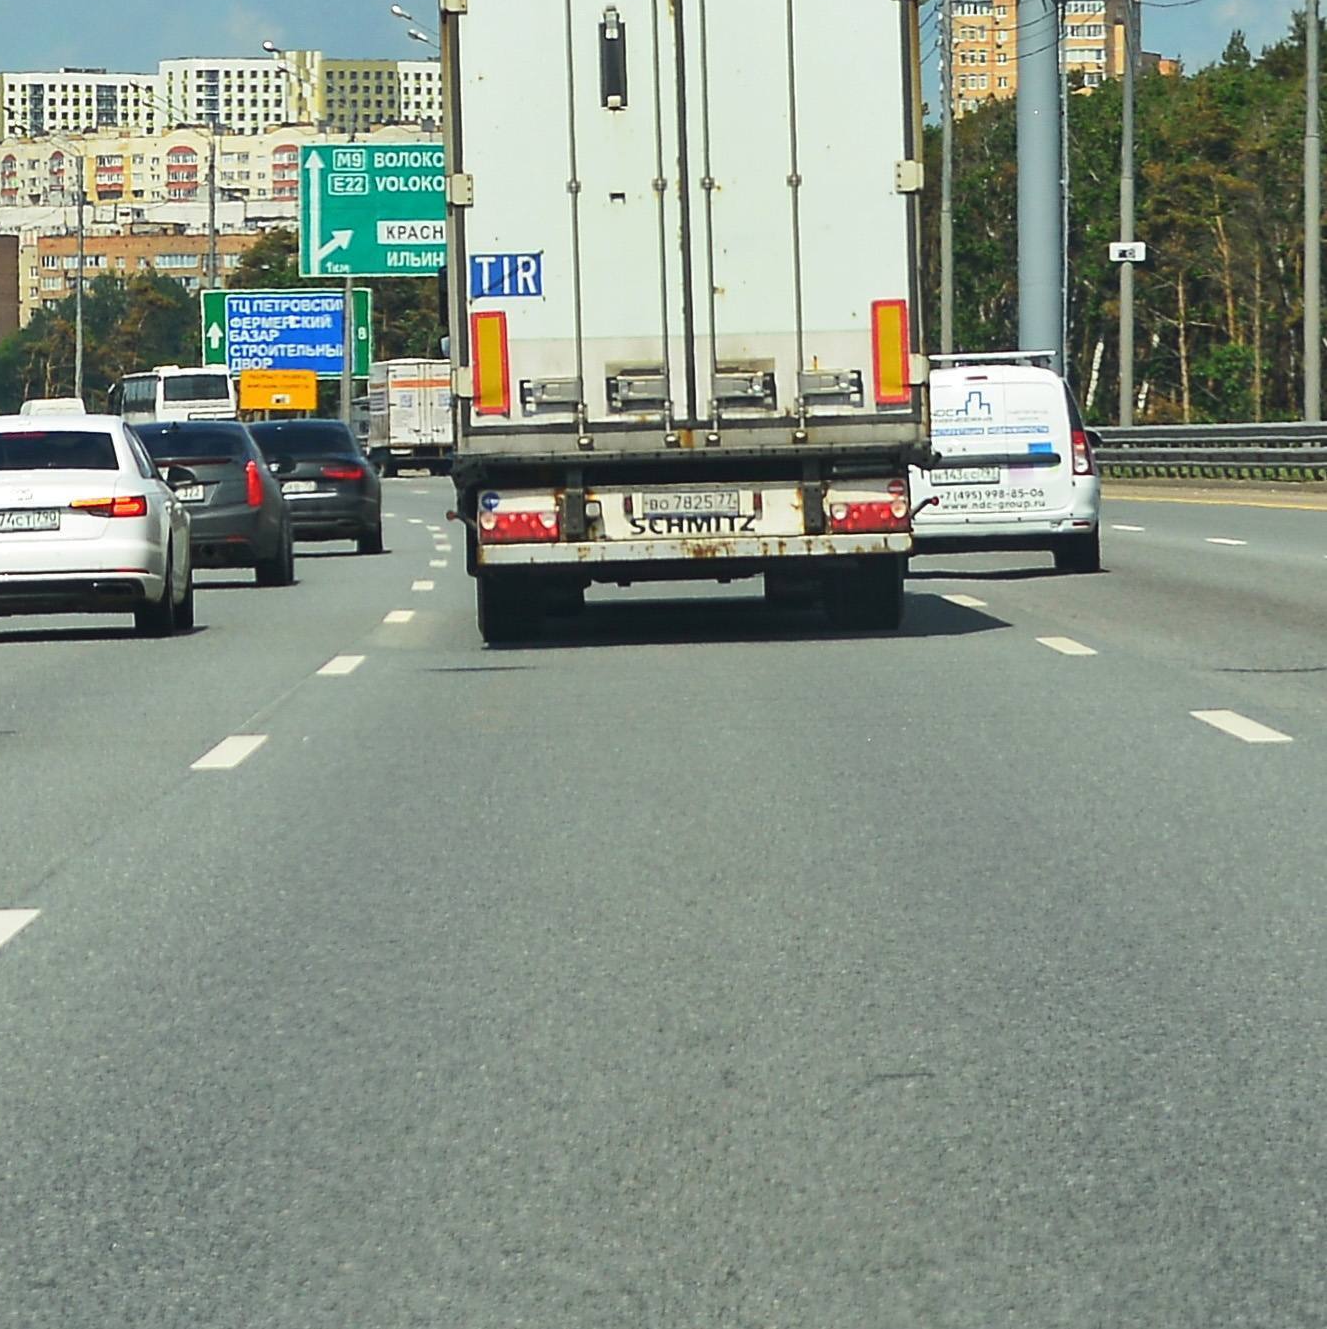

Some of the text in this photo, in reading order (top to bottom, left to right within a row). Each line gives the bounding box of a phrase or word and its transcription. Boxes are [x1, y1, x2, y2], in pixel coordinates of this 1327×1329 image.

[334, 177, 364, 192] E22
[475, 256, 537, 295] TIR
[230, 299, 250, 314] ТЦ
[230, 330, 280, 342] БАЗАР
[231, 357, 273, 371] ДВОР
[630, 515, 756, 535] SCHMITZ
